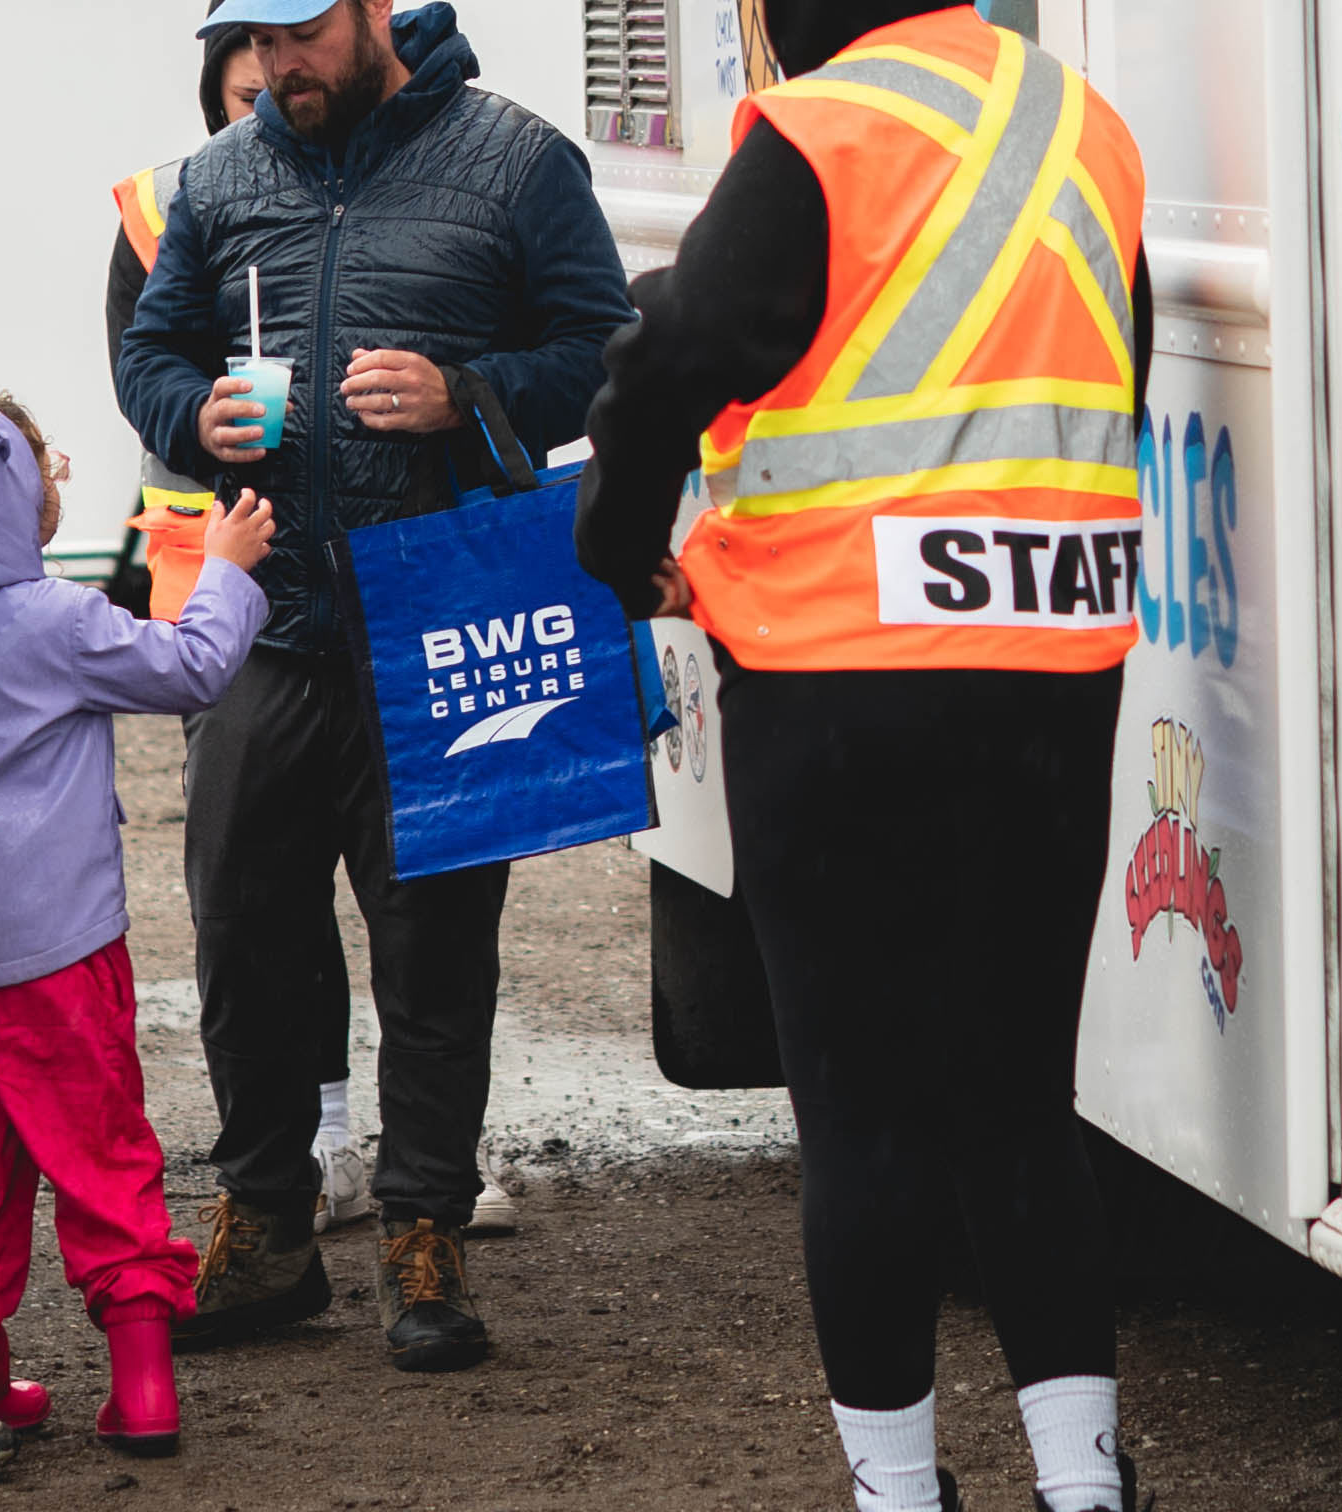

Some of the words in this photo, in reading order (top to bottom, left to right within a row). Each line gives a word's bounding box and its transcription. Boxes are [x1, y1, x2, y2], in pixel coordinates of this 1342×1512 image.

[421, 604, 575, 670] BWG
[427, 647, 582, 695] LEISURE
[430, 672, 585, 719] CENTRE
[1151, 717, 1205, 832] TINY
[1125, 813, 1243, 1015] SEEDLINGS
